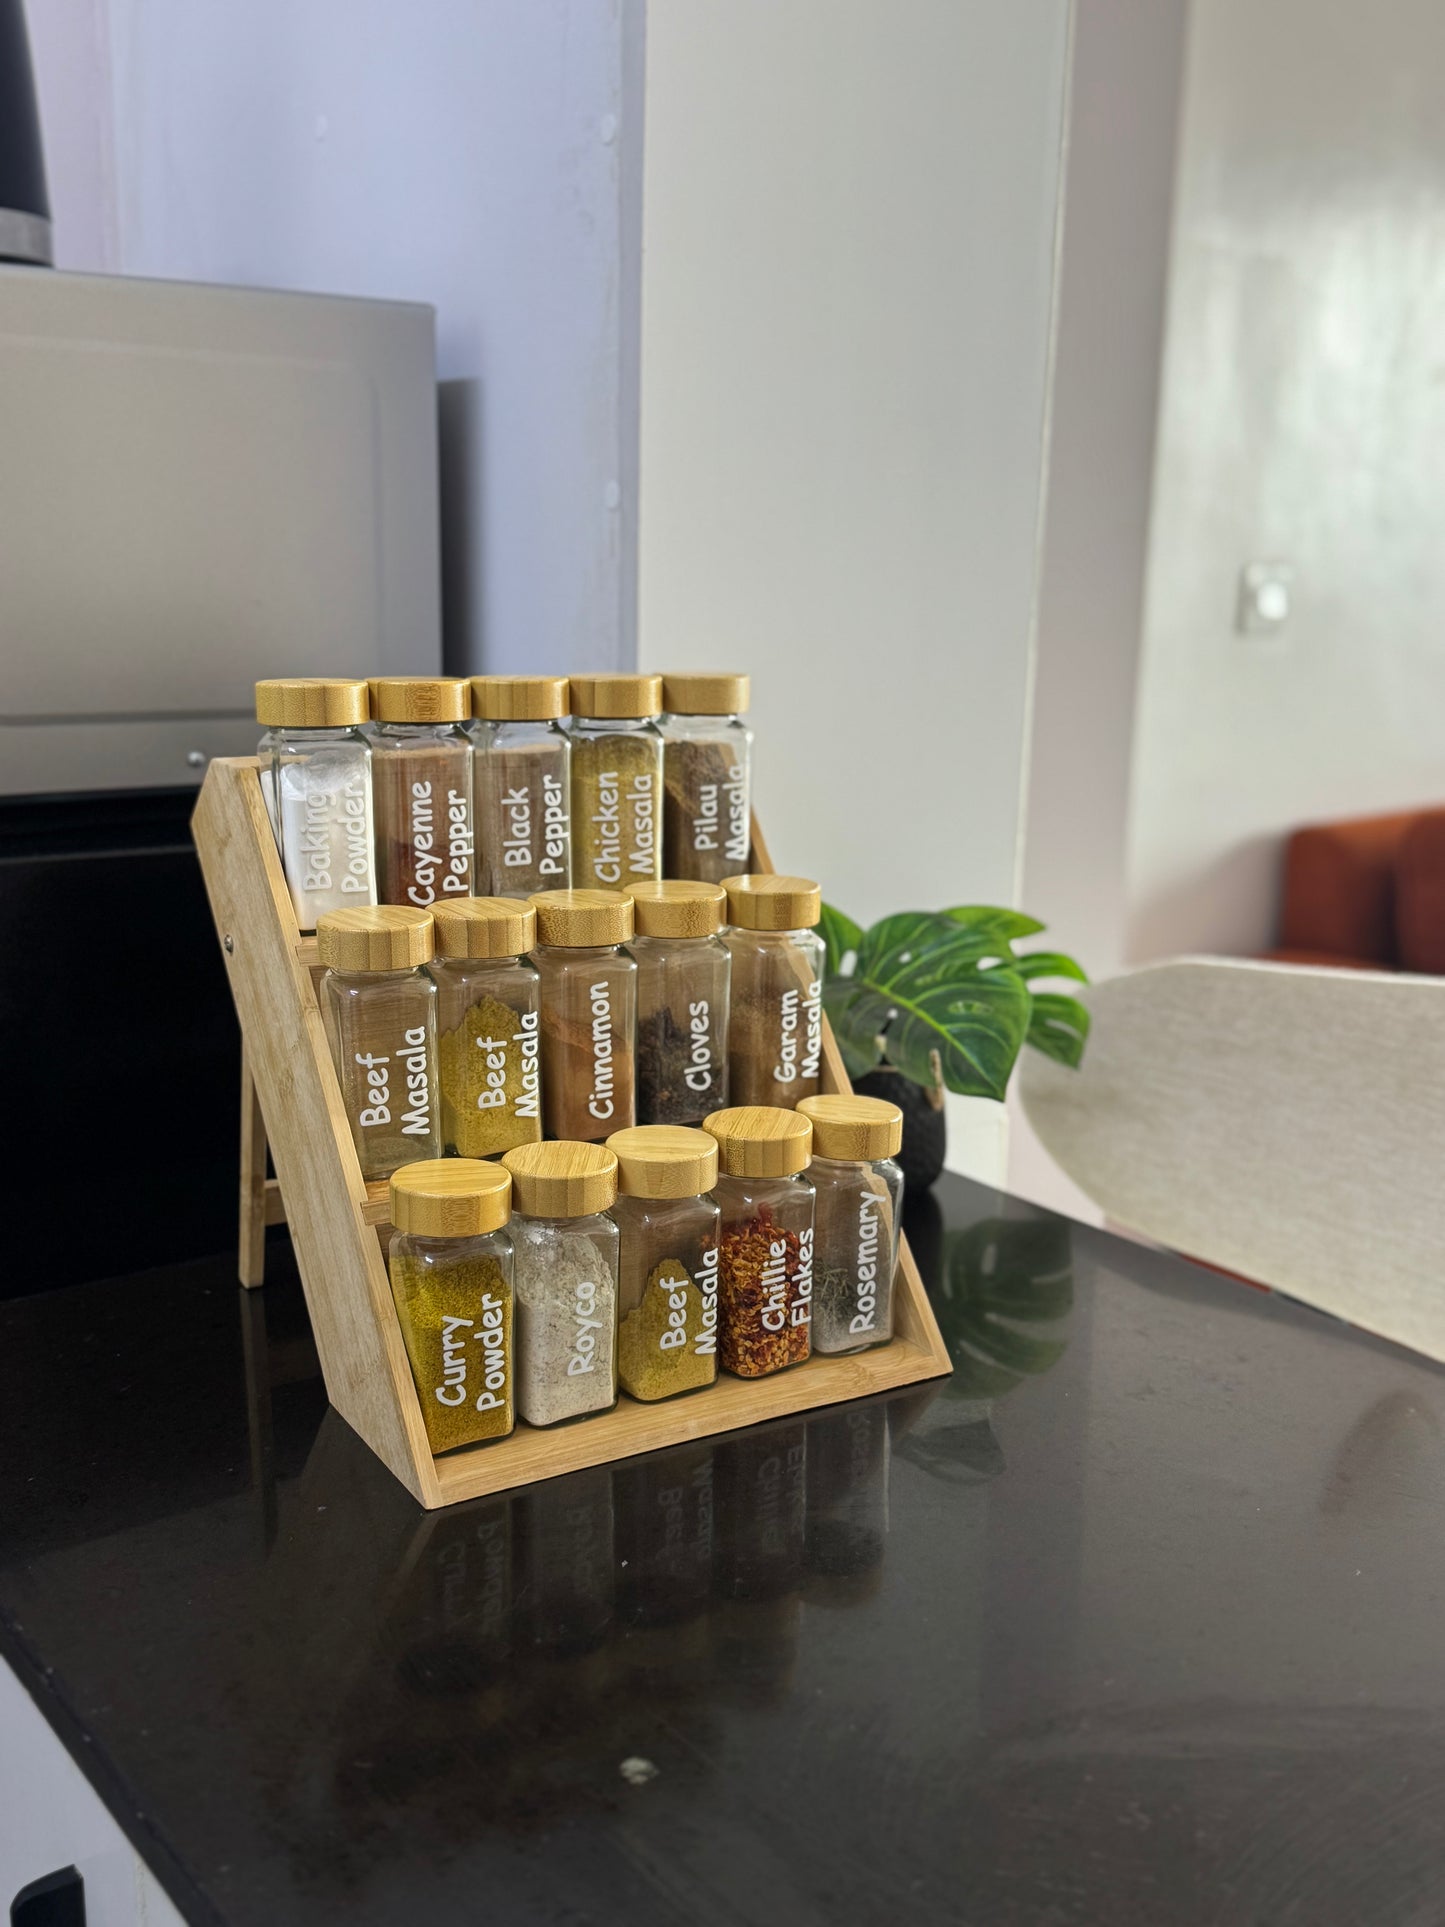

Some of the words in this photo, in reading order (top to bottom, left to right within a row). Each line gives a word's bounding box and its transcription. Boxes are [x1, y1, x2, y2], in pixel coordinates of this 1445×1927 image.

[302, 789, 336, 891] Baking
[341, 781, 368, 892] Powder
[408, 781, 435, 906] Cayenne
[443, 790, 474, 892] Pepper
[501, 787, 532, 867] Black
[540, 774, 569, 874] Pepper
[594, 770, 621, 883] Chicken
[627, 774, 654, 874] Masala
[695, 784, 718, 851] Pilau
[725, 764, 749, 860] Masala
[476, 1036, 507, 1110] Beef
[513, 1011, 539, 1117] Masala
[589, 981, 614, 1120] Cinnamon
[685, 1000, 712, 1092] Cloves
[774, 988, 799, 1083] Garam
[801, 980, 822, 1078] Masala
[356, 1052, 390, 1127] Beef
[396, 1026, 431, 1135] Masala
[695, 1248, 719, 1355] Masala
[760, 1238, 786, 1331] Chillie
[791, 1228, 814, 1327] Flakes
[849, 1191, 886, 1335] Rosemary
[436, 1315, 473, 1407] Curry
[474, 1293, 504, 1412] Powder
[568, 1281, 603, 1377] Royco
[660, 1276, 689, 1350] Beef
